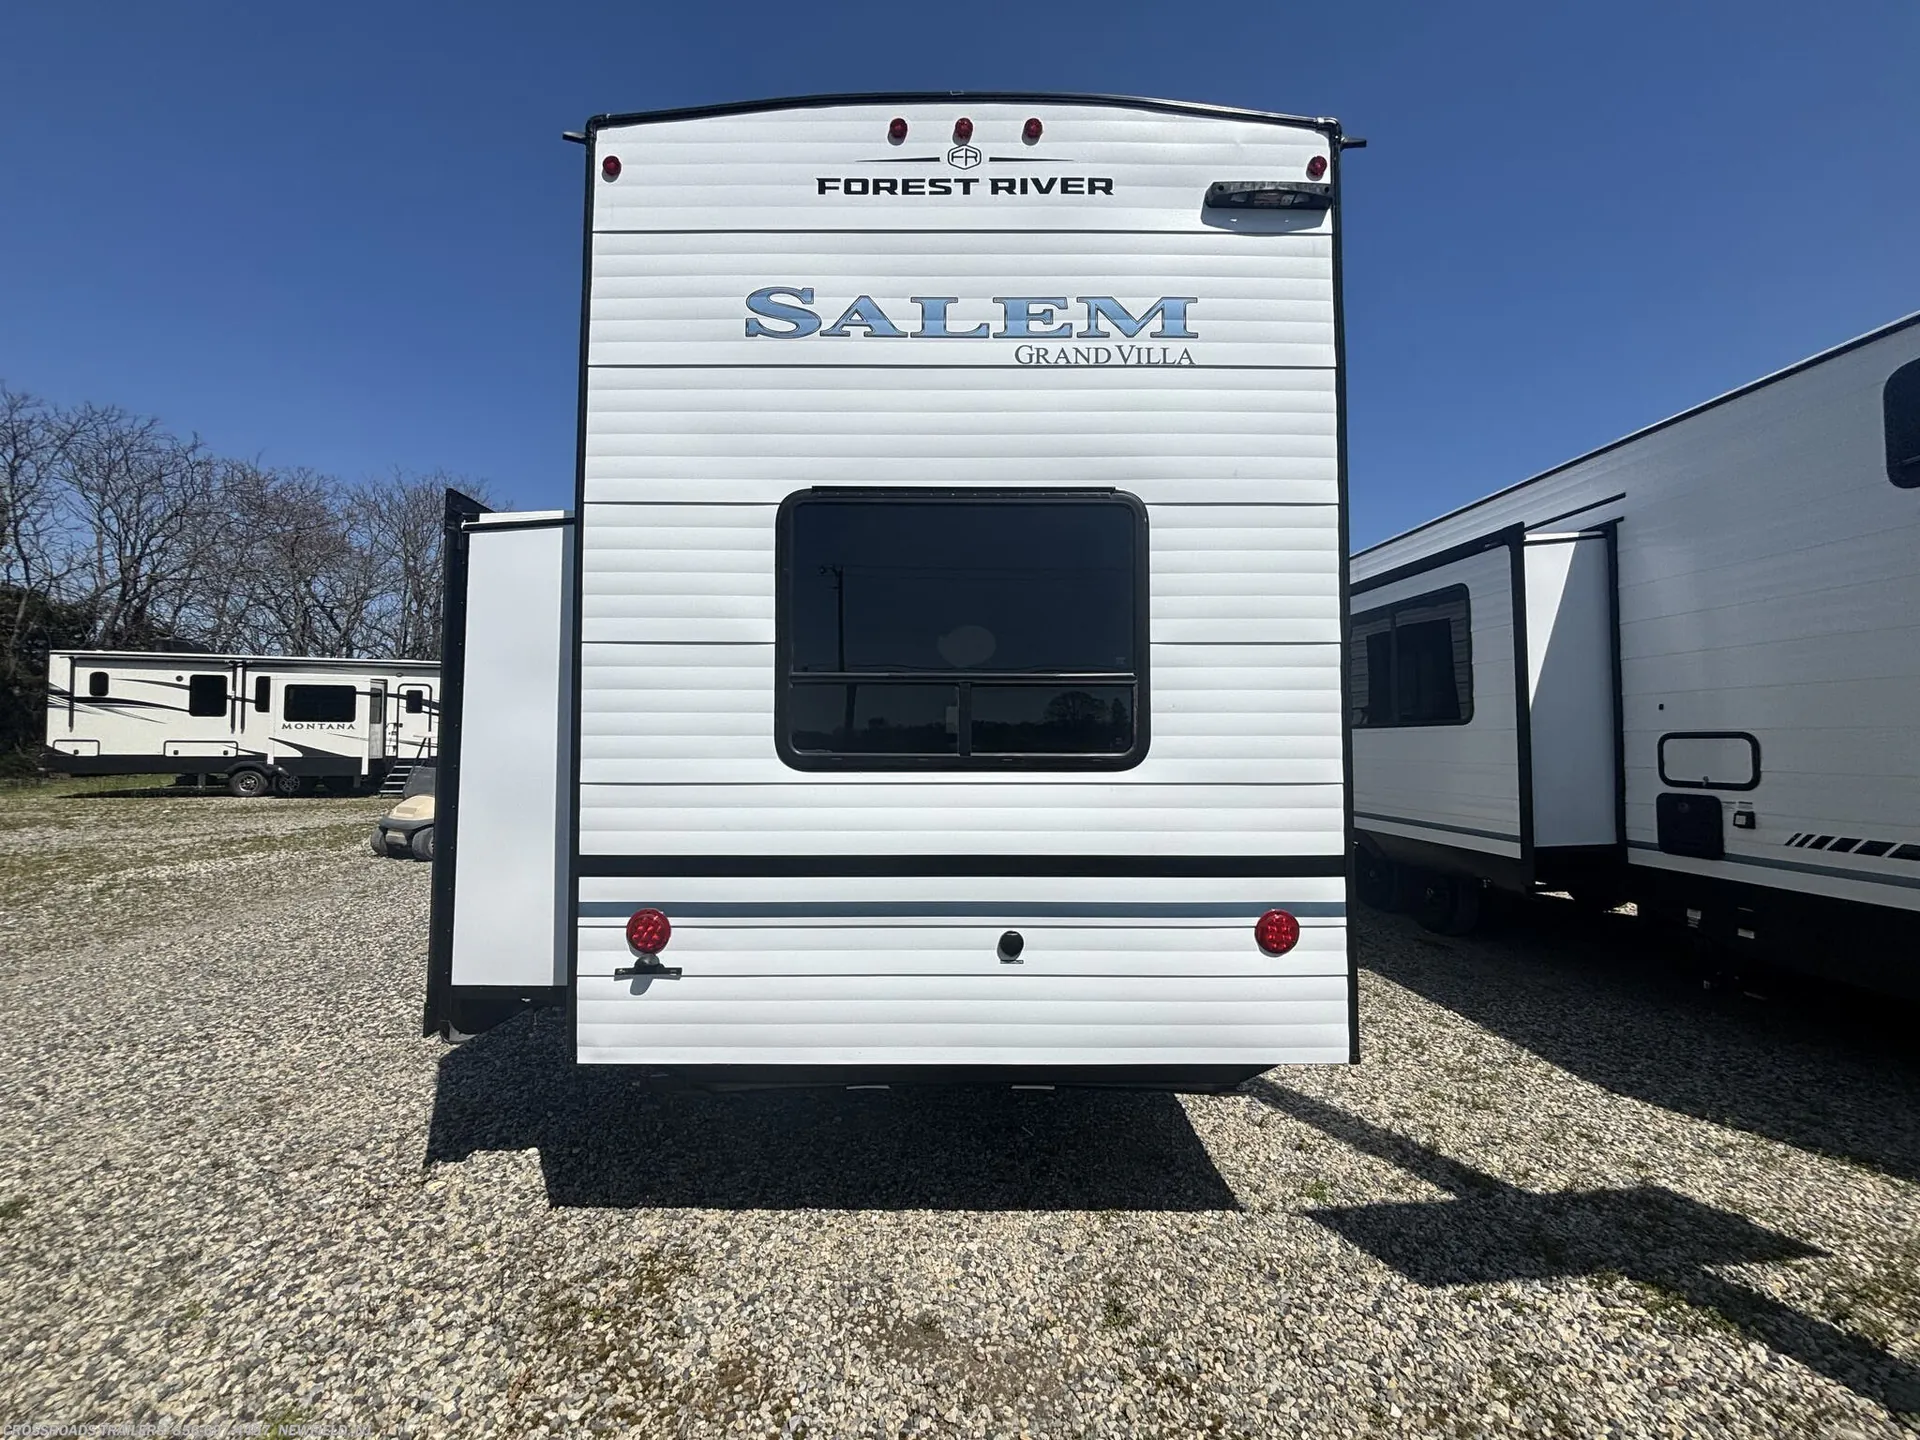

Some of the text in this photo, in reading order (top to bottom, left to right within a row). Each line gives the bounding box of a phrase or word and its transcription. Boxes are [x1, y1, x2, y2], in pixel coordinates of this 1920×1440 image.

[816, 177, 1114, 196] FOREST RIVER
[745, 286, 1199, 340] SALEM
[1014, 344, 1197, 365] GRAND VILLA
